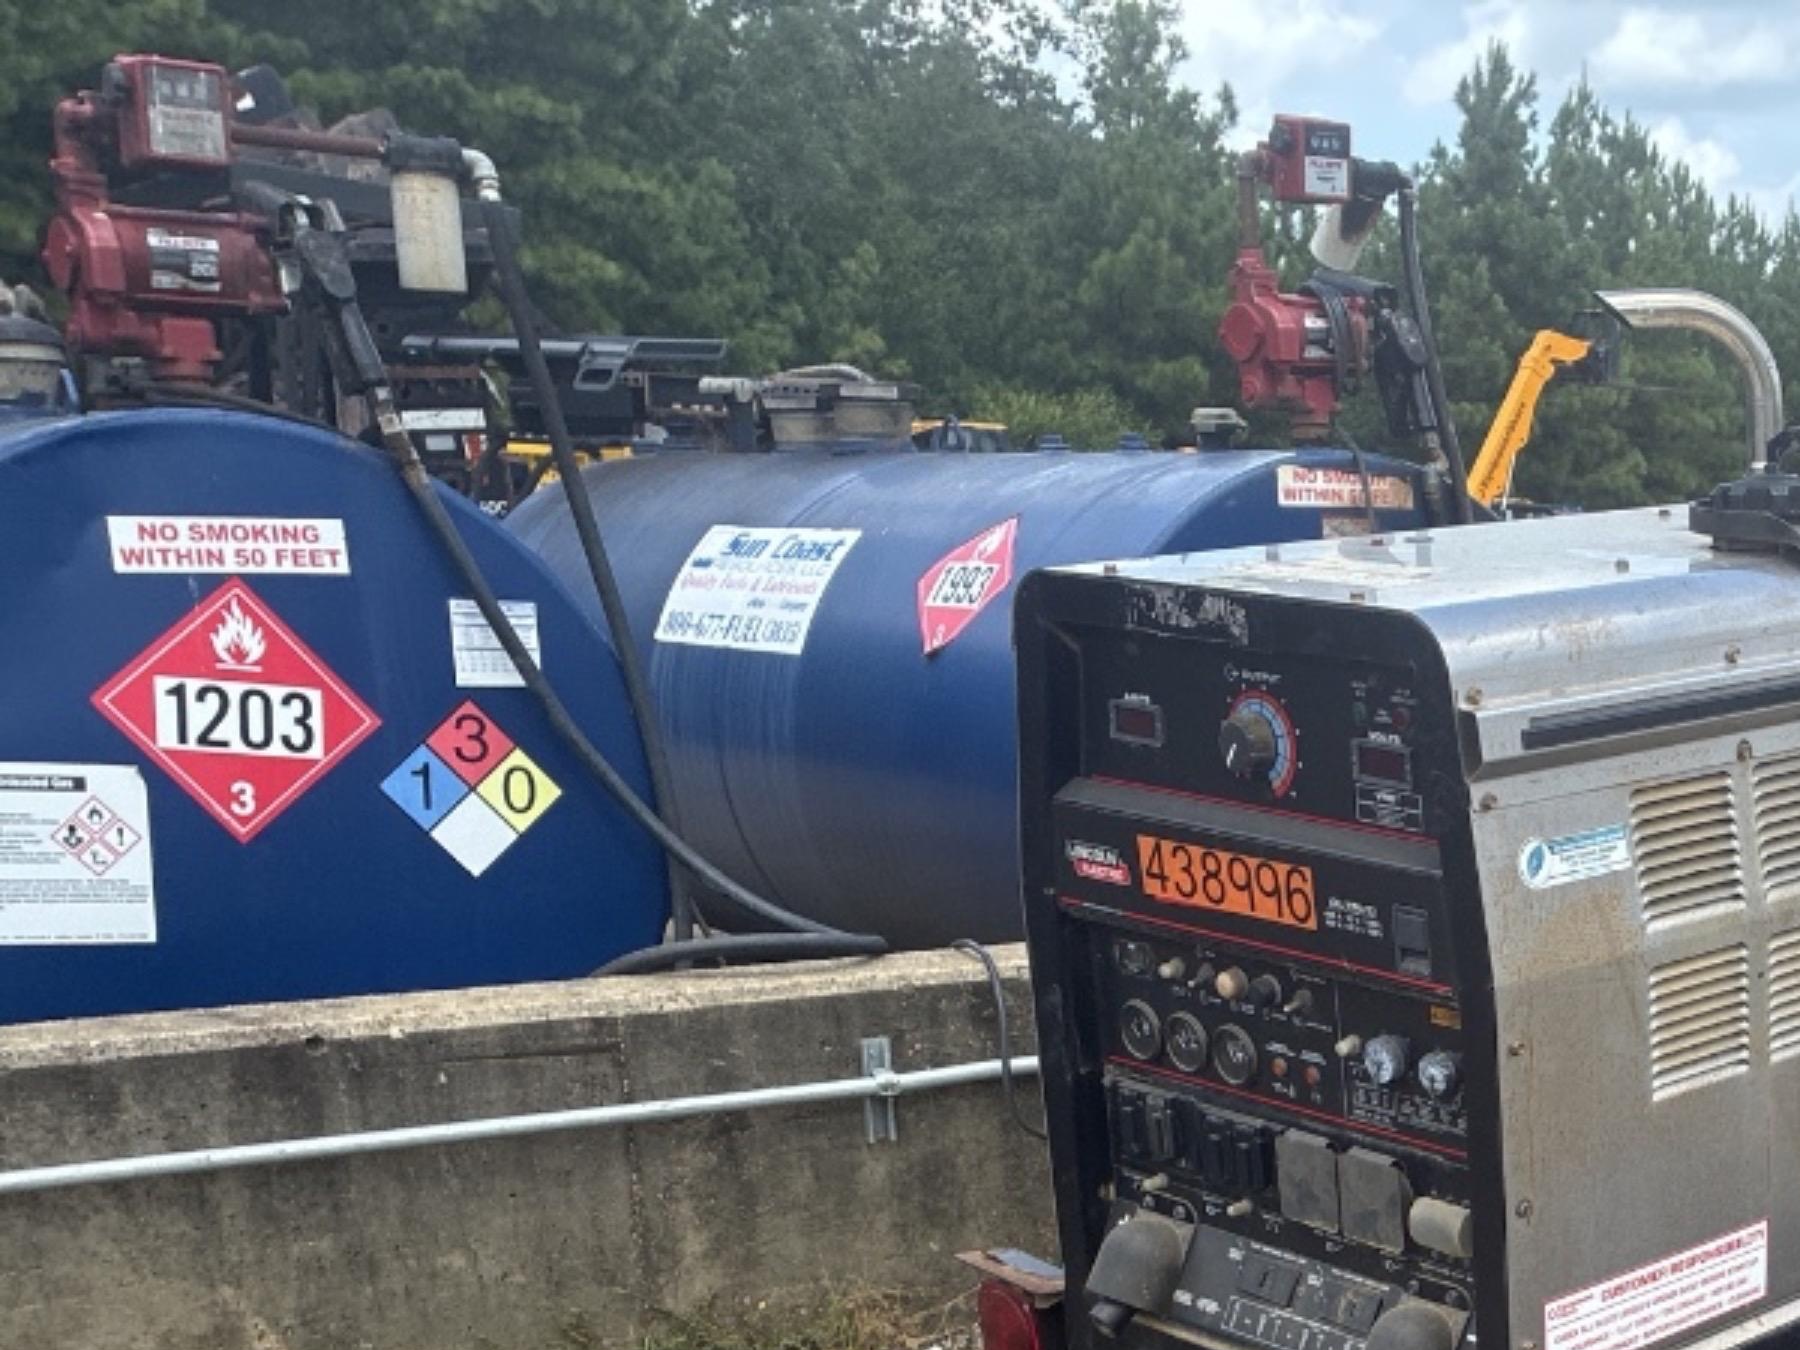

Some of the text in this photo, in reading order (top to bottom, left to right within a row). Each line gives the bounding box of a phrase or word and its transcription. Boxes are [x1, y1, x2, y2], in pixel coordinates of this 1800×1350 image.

[137, 524, 319, 543] NO SMOKING
[720, 533, 846, 561] Sun Coast
[120, 548, 341, 568] WITHIN 50 FEET
[933, 566, 995, 604] 1993
[932, 623, 947, 647] 3
[164, 681, 315, 754] 1203
[454, 713, 490, 764] 3
[230, 780, 257, 816] 3
[411, 761, 432, 811] 1
[503, 765, 537, 815] 0
[1145, 842, 1313, 925] 438996
